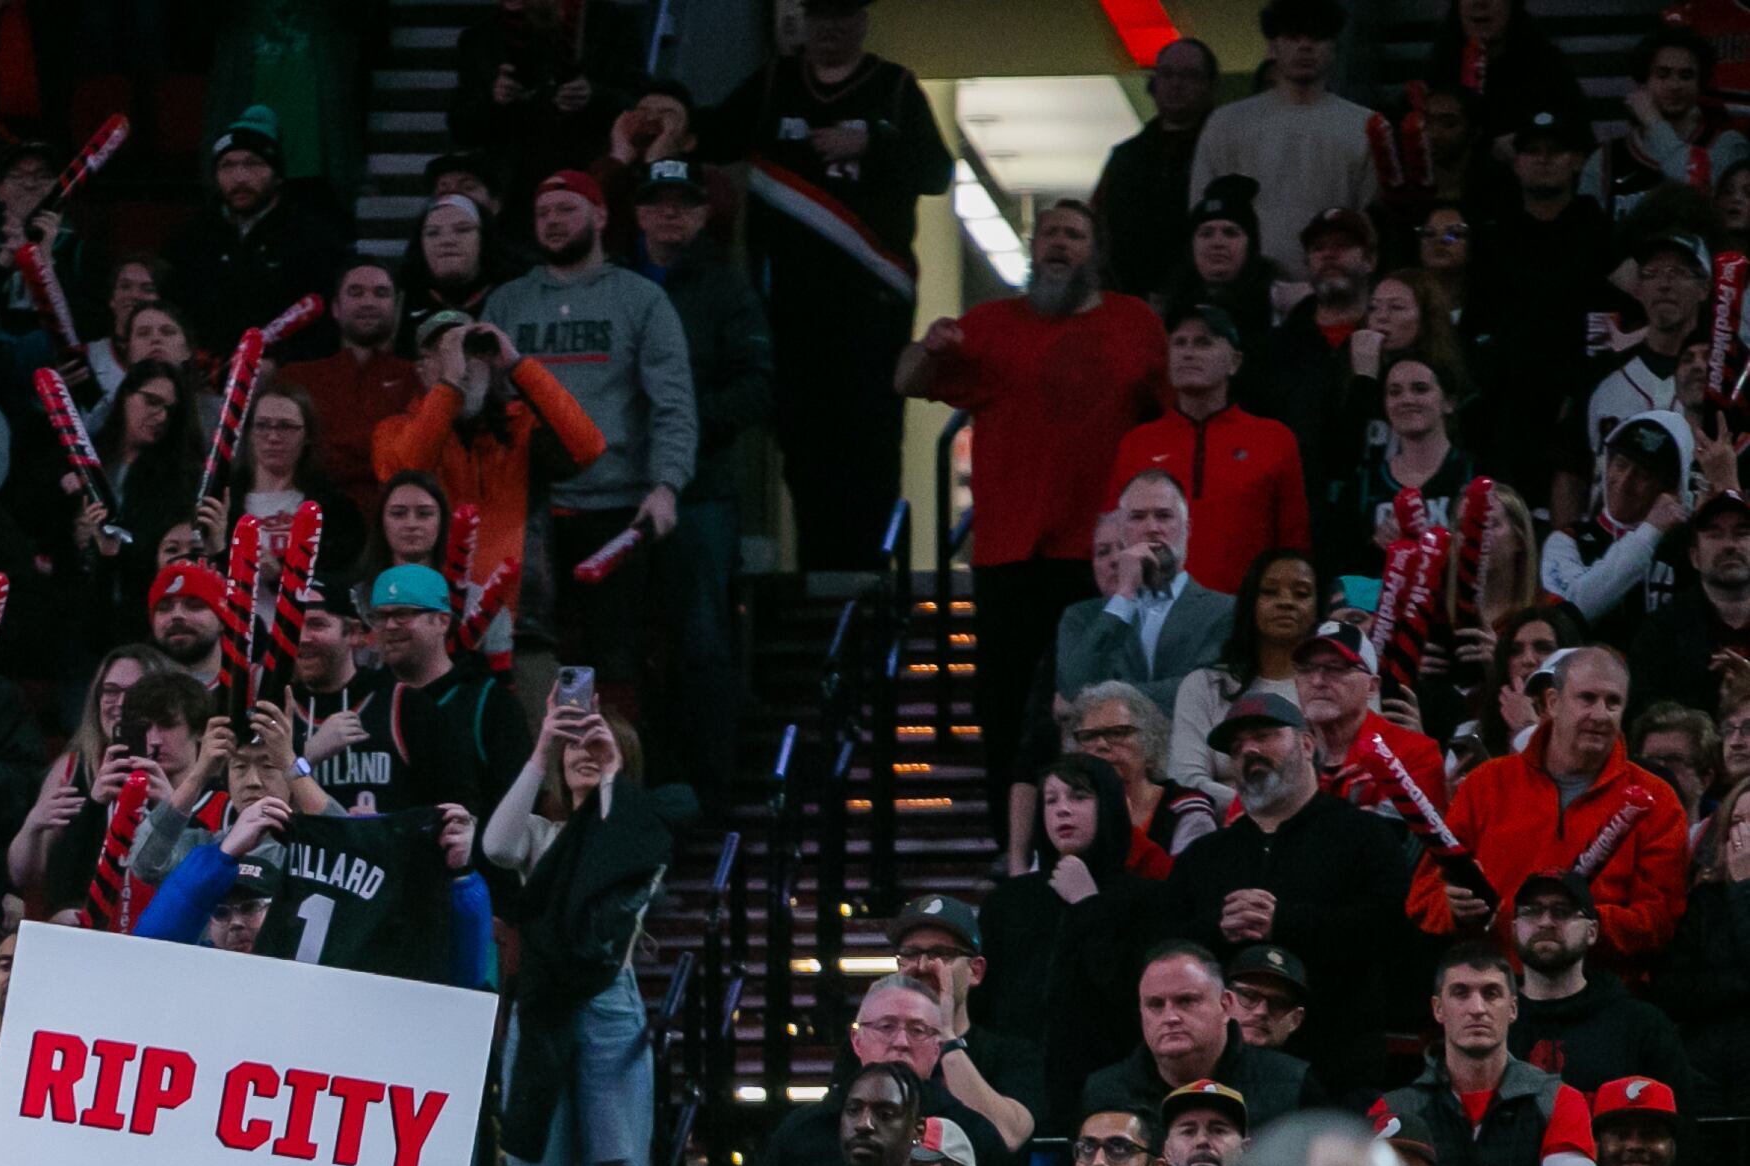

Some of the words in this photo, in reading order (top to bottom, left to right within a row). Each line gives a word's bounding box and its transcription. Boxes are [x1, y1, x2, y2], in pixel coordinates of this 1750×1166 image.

[313, 752, 392, 785] TLAND
[290, 842, 385, 901] LILLARD
[297, 893, 336, 966] 1
[19, 1028, 197, 1137] RIP
